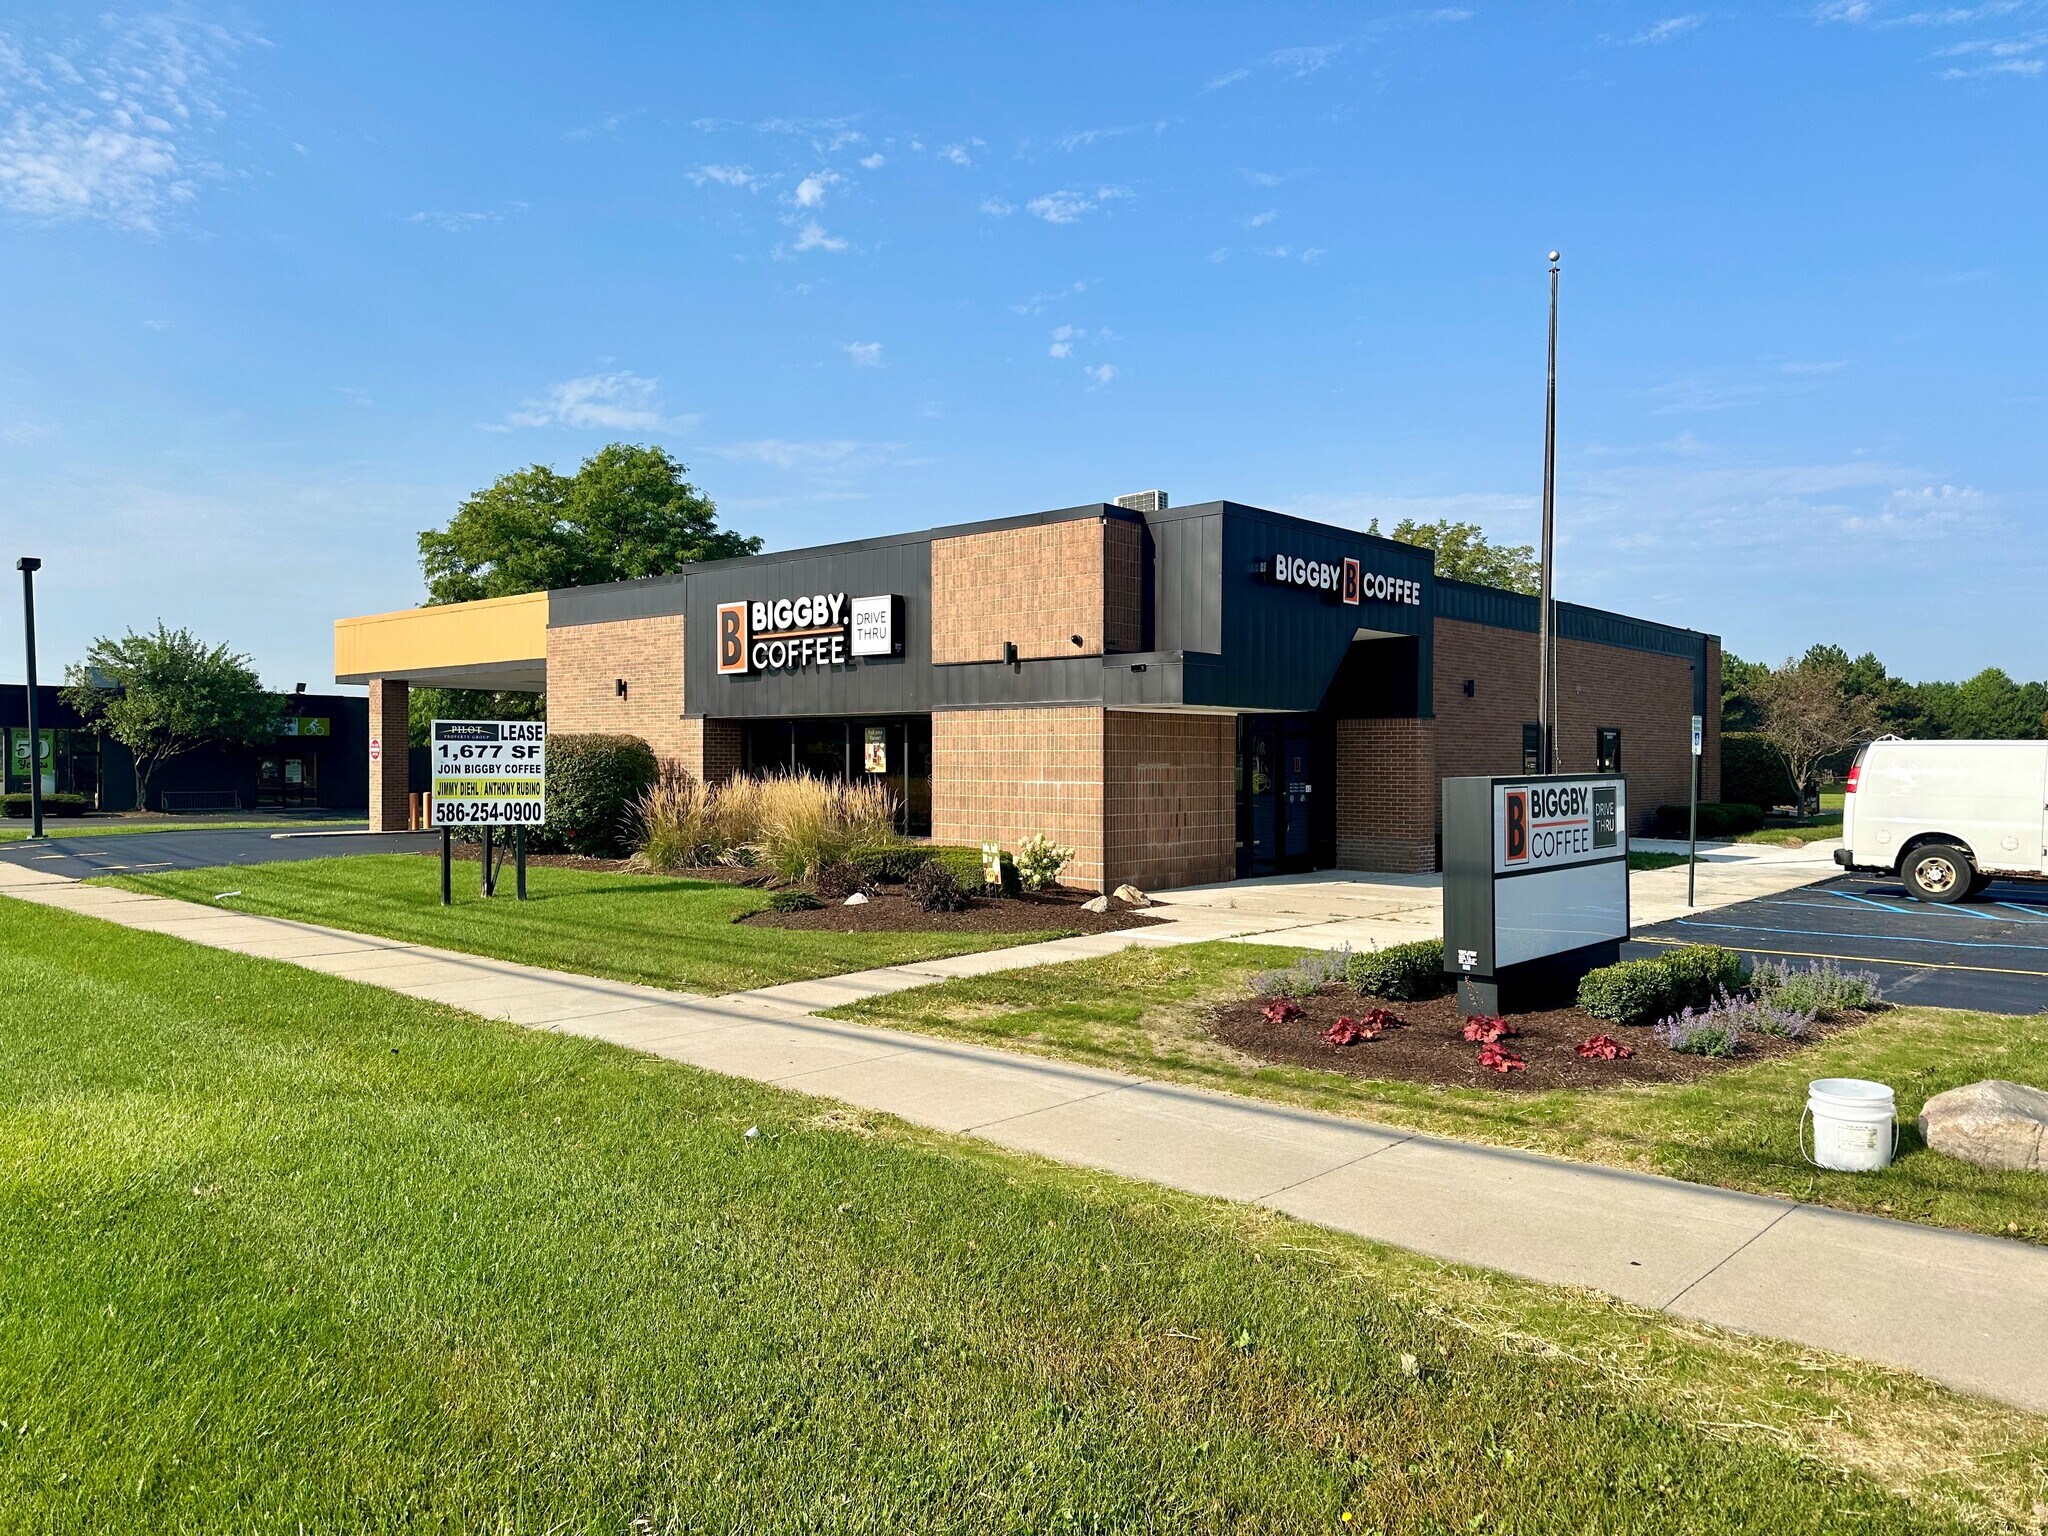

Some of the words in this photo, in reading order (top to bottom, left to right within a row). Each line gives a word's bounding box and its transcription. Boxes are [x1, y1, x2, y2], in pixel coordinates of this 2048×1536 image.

[1276, 554, 1340, 591] BIGGBY
[1363, 572, 1421, 605] COFFEE
[856, 611, 887, 625] DRIVE
[722, 611, 742, 666] B
[857, 627, 887, 640] THRU
[752, 636, 845, 669] COFFEE
[451, 725, 483, 734] PILOT
[501, 725, 543, 741] LEASE
[438, 744, 503, 761] 1,677
[511, 745, 541, 759] SF
[17, 760, 49, 769] Yers
[438, 764, 461, 774] JOIN
[464, 764, 502, 774] BIGGBY
[505, 764, 541, 774] COFFEE
[437, 782, 459, 796] JIMMY
[460, 782, 479, 796] DIEHL
[484, 782, 515, 796] ANTHONY
[516, 782, 541, 796] RUBINO
[436, 802, 542, 823] 586-254-0900
[1595, 801, 1615, 816] DRIVE
[1509, 795, 1525, 857] B
[1596, 817, 1615, 833] THRU
[1531, 828, 1589, 859] COFFEE
